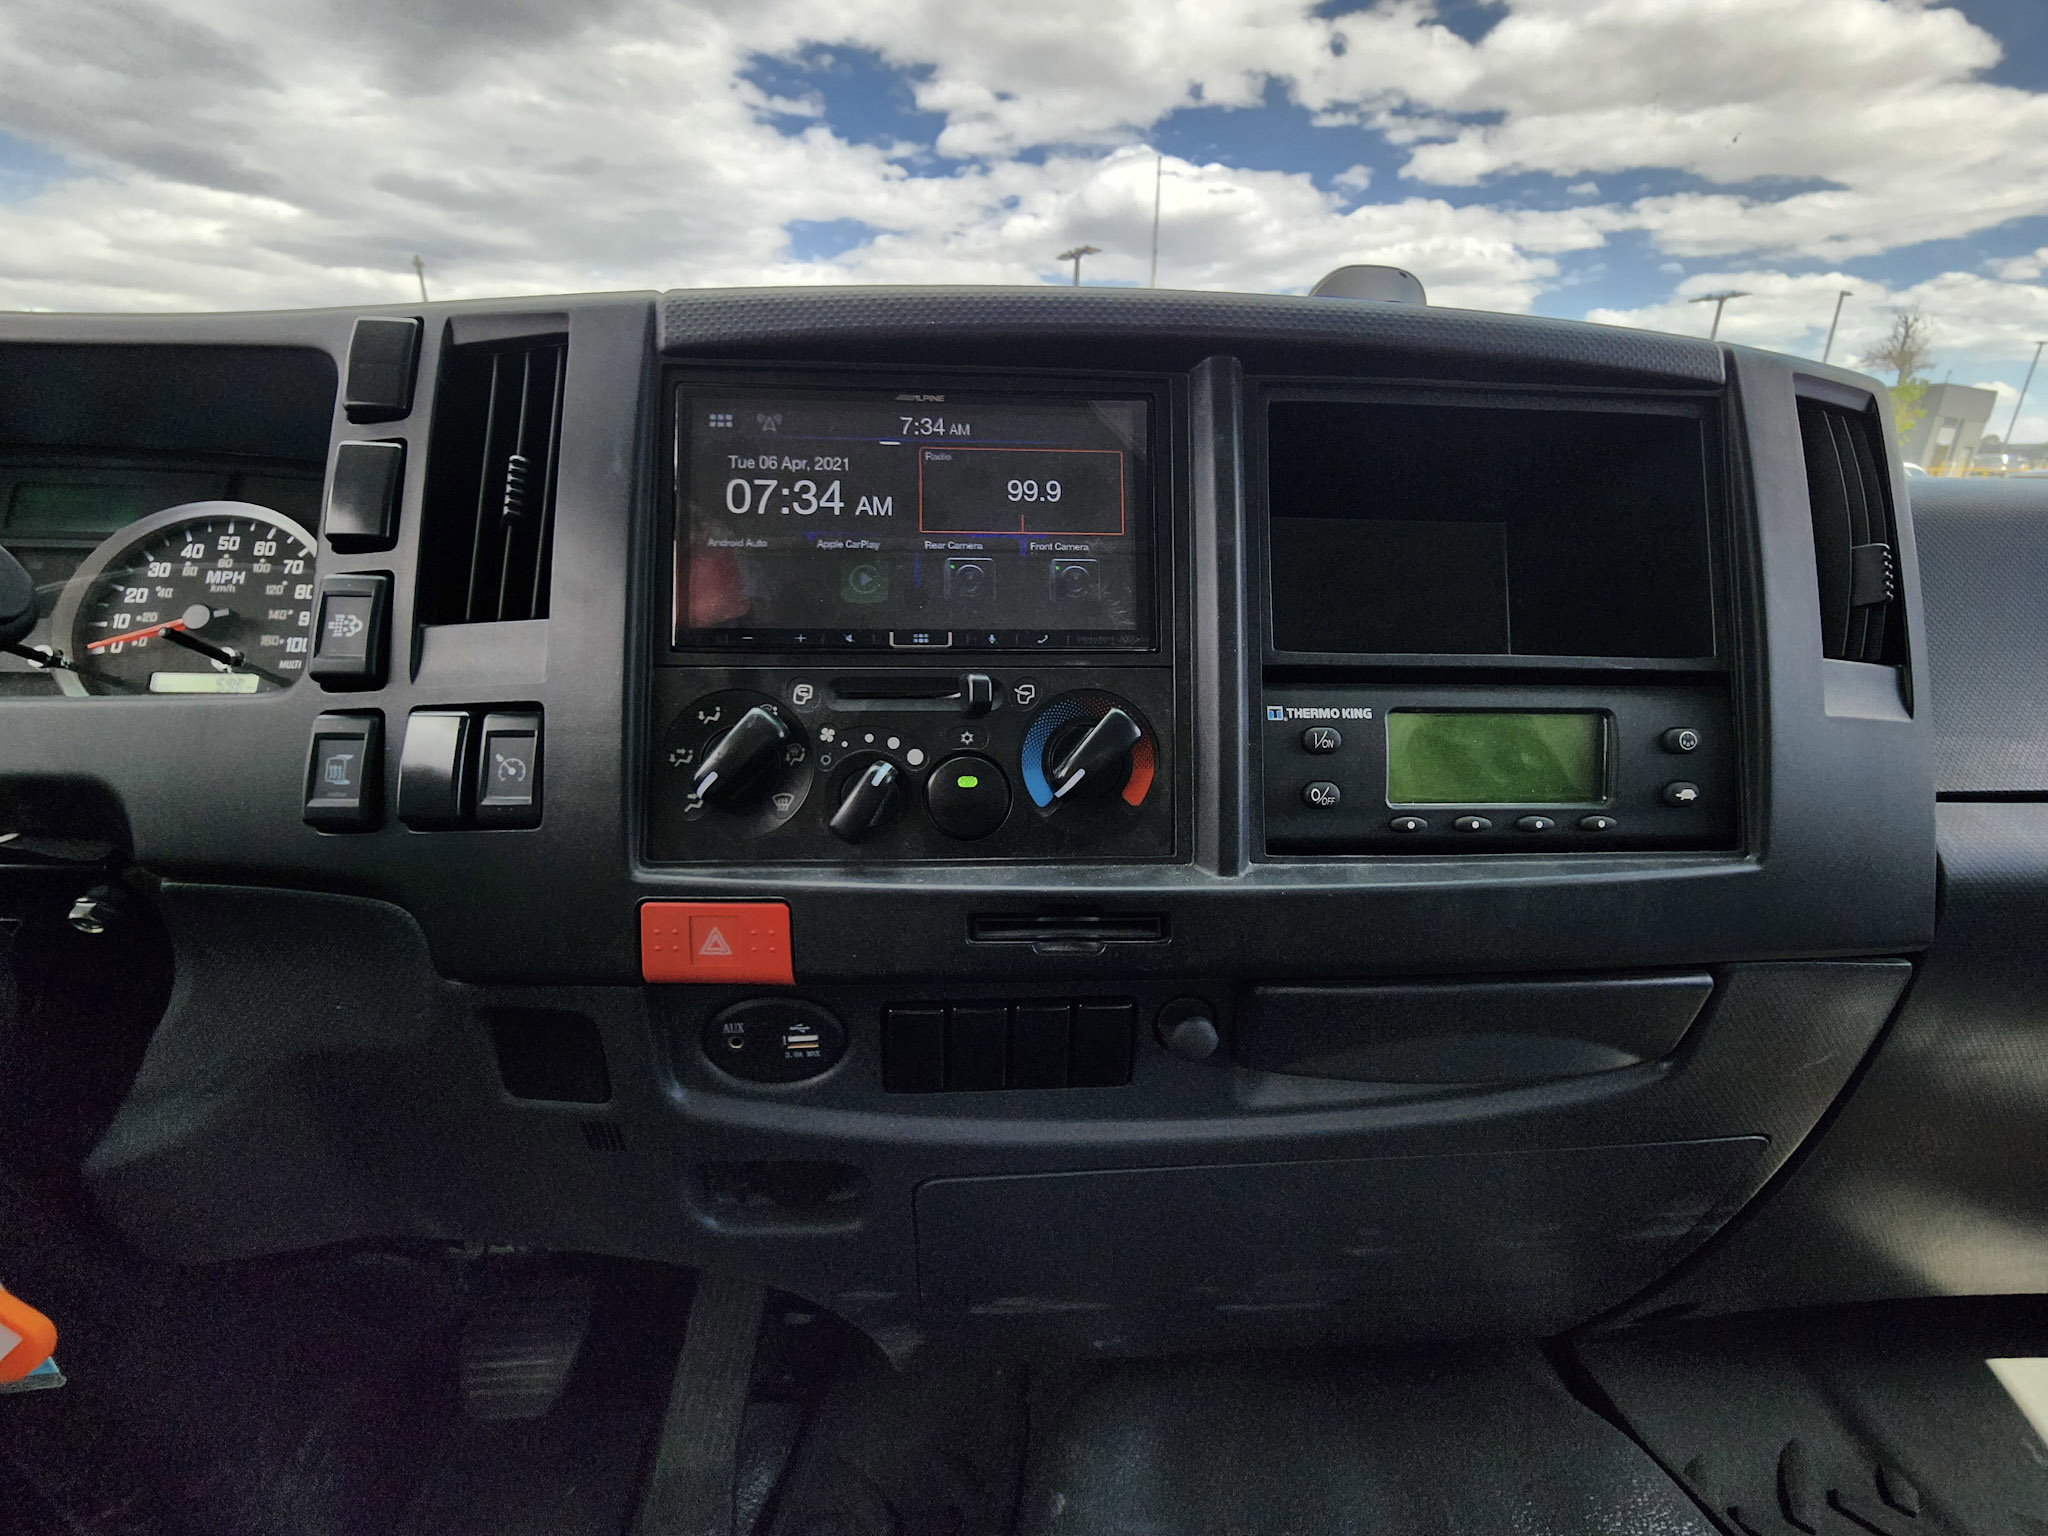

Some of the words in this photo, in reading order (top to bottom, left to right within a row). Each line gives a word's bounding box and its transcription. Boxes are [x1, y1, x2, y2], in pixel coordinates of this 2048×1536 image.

[900, 417, 946, 436] 7:34
[949, 423, 971, 436] AM
[728, 455, 755, 470] Tue
[759, 456, 778, 470] 06
[781, 456, 811, 473] Apr,
[814, 457, 850, 472] 2021
[925, 451, 952, 462] Radio
[726, 478, 845, 516] 07:34
[855, 496, 893, 516] AM
[1007, 479, 1062, 503] 99.9
[180, 543, 205, 558] 40
[217, 535, 241, 551] 50
[253, 541, 277, 556] 60
[707, 538, 744, 548] Android
[746, 538, 768, 548] Auto
[817, 539, 844, 550] Apple
[845, 539, 881, 550] CarPlay
[925, 540, 947, 550] Rear
[949, 541, 983, 550] Camera
[1030, 542, 1053, 551] Front
[1055, 542, 1089, 551] Camera
[147, 562, 172, 578] 30
[252, 563, 272, 573] 100
[282, 559, 305, 574] 70
[205, 570, 247, 585] MPH
[124, 587, 149, 603] 20
[209, 584, 236, 593] km/h
[265, 584, 284, 596] 120
[112, 613, 131, 629] 10
[141, 611, 159, 623] 20
[297, 611, 311, 626] 9
[279, 659, 302, 669] MULTI
[1286, 707, 1340, 719] THERMO
[1342, 707, 1372, 720] KING
[722, 1022, 745, 1034] AUX
